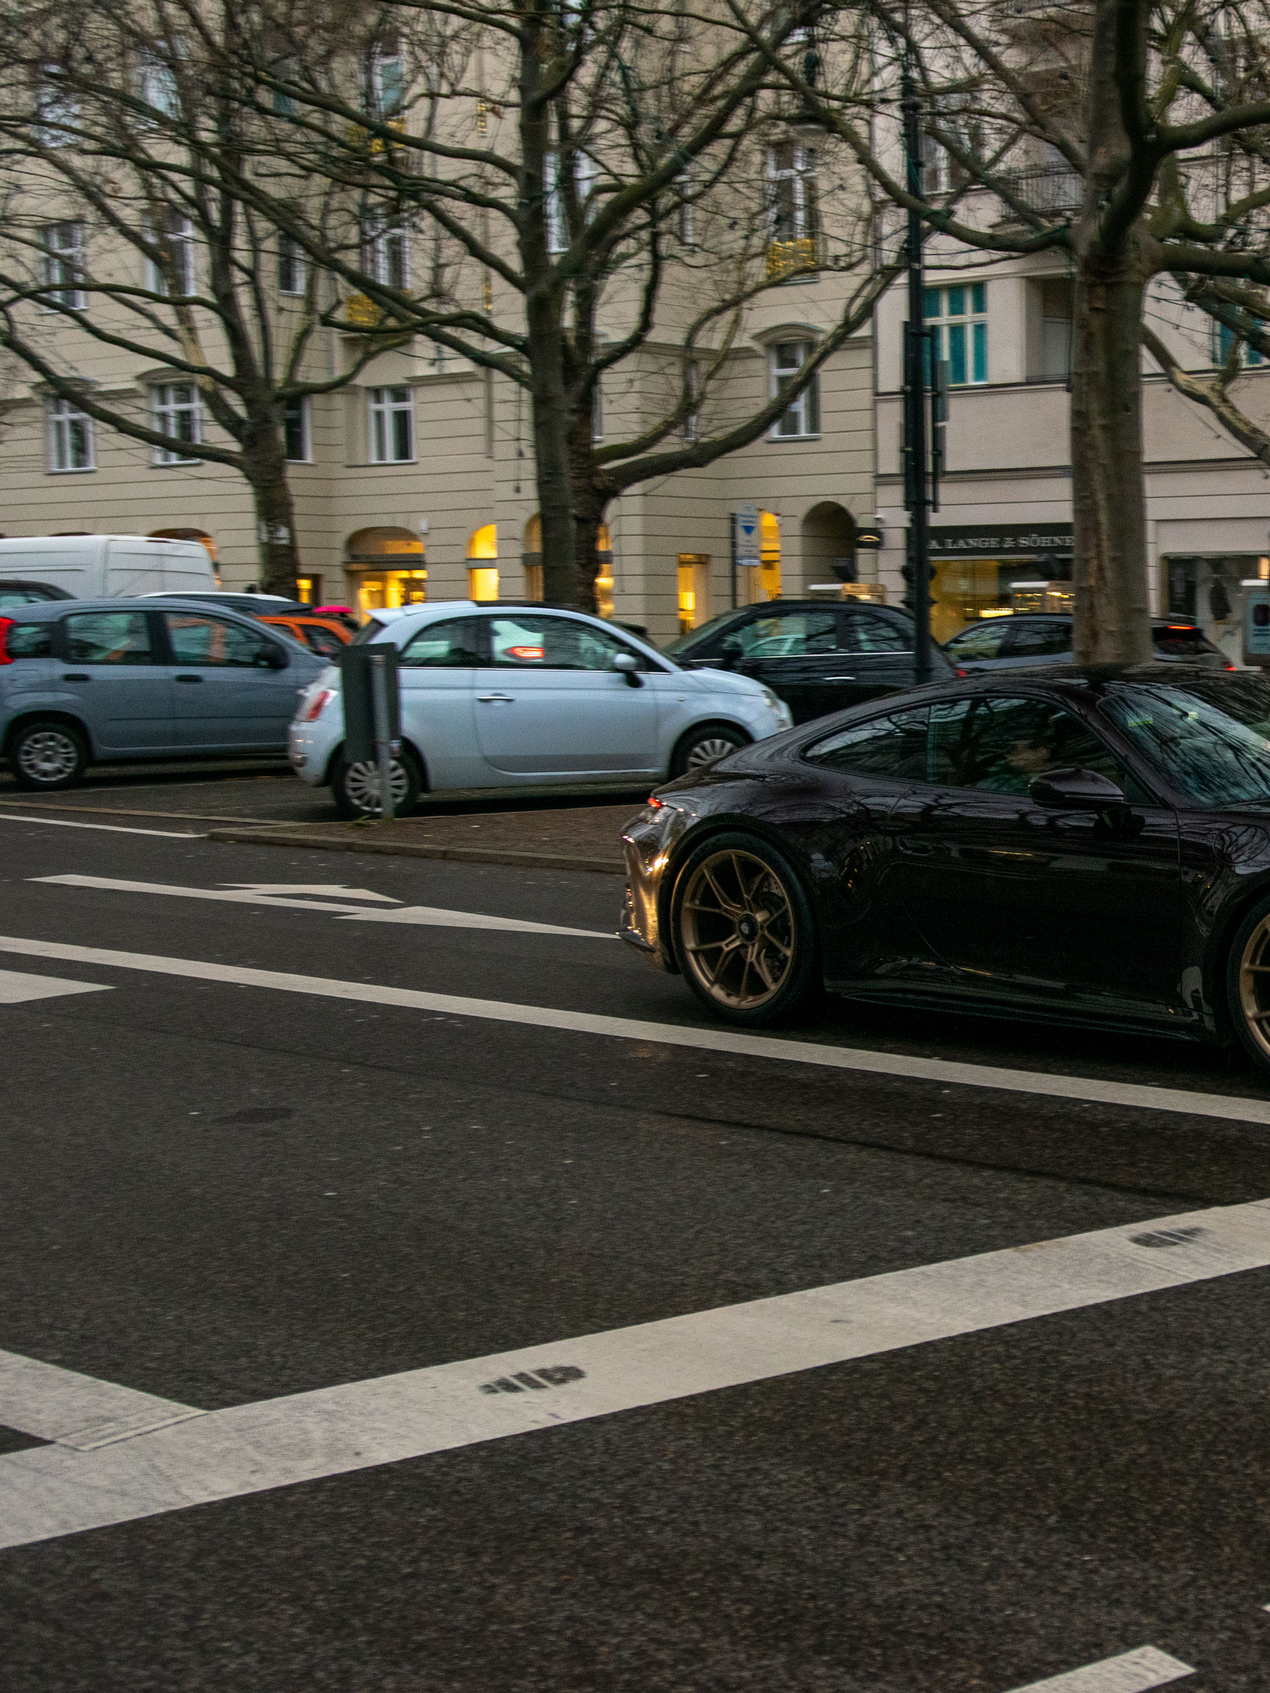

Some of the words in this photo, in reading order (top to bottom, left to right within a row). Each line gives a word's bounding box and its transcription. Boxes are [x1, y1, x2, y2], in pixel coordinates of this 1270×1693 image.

[943, 537, 1000, 549] LANGE
[1003, 537, 1016, 548] &
[1018, 533, 1075, 548] SÖHNE
